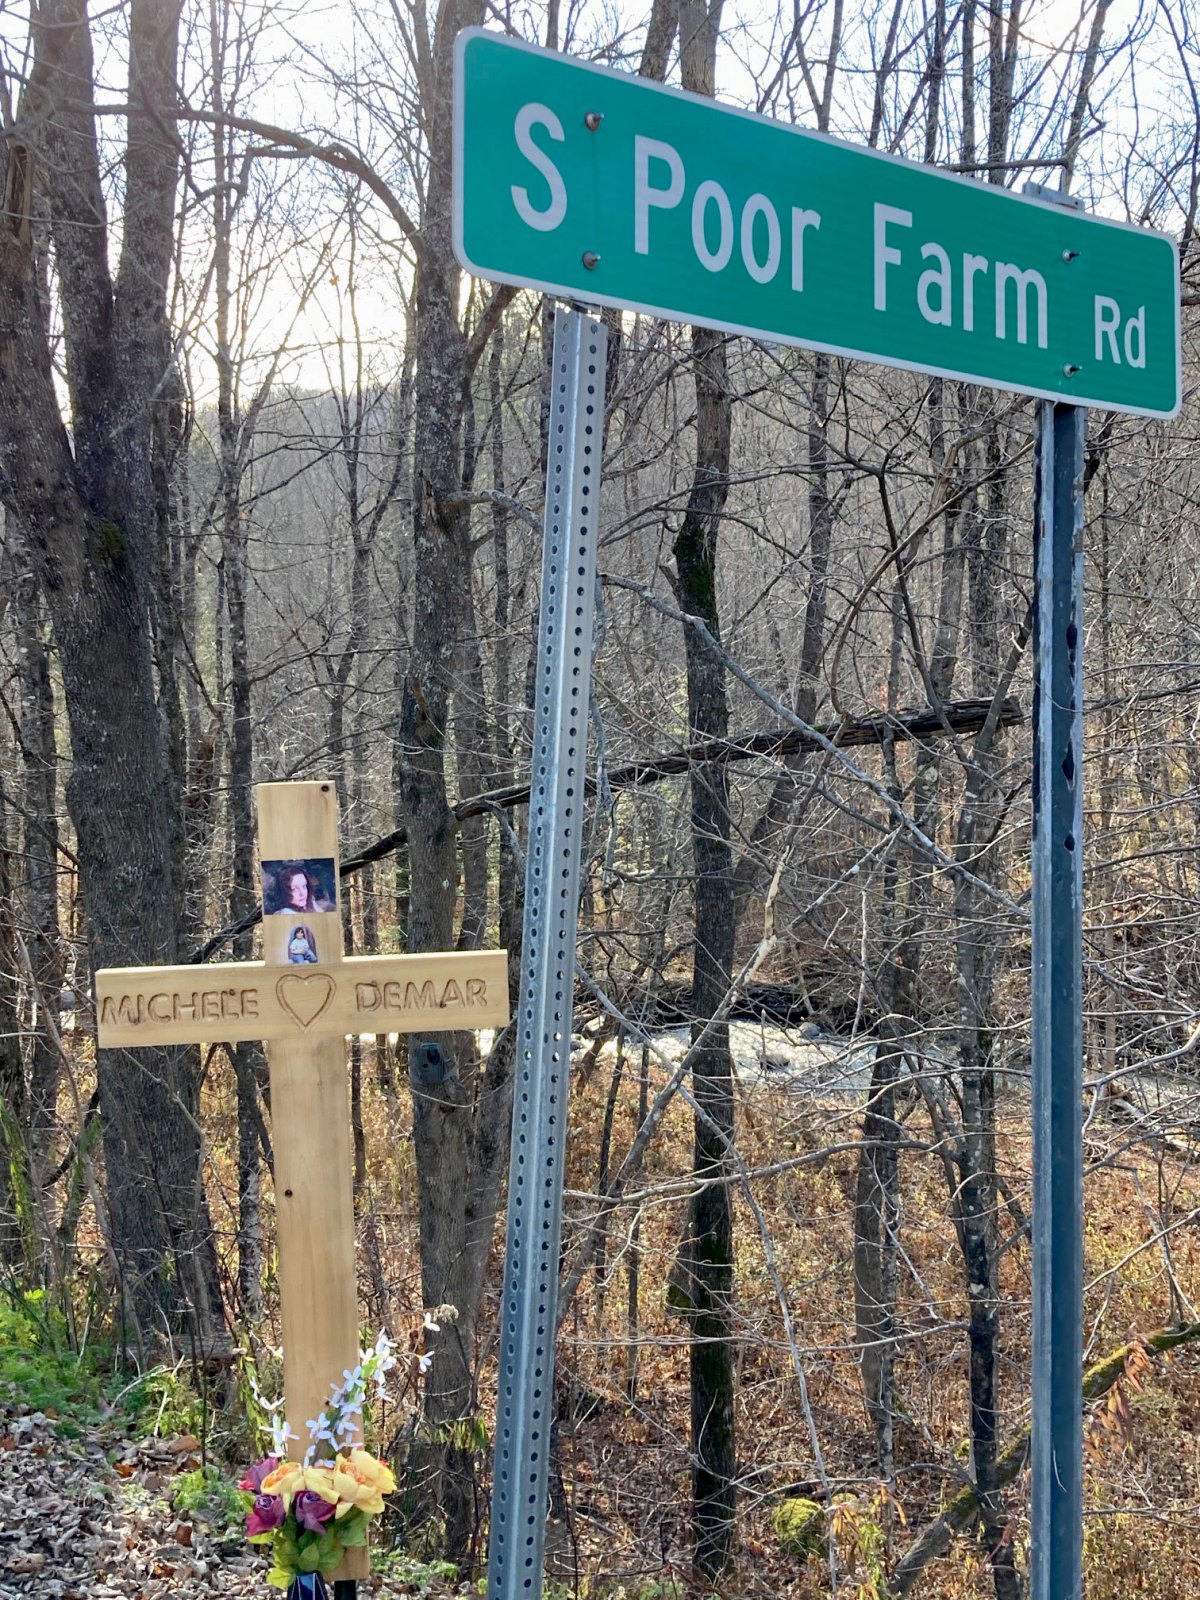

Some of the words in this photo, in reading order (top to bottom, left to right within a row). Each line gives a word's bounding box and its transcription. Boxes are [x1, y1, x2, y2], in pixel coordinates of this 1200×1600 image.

[511, 103, 567, 231] S
[635, 135, 821, 292] Poor
[874, 203, 1048, 349] Farm
[1094, 295, 1146, 369] Rd
[100, 988, 260, 1025] MICHELE
[354, 978, 488, 1012] DEMAR
